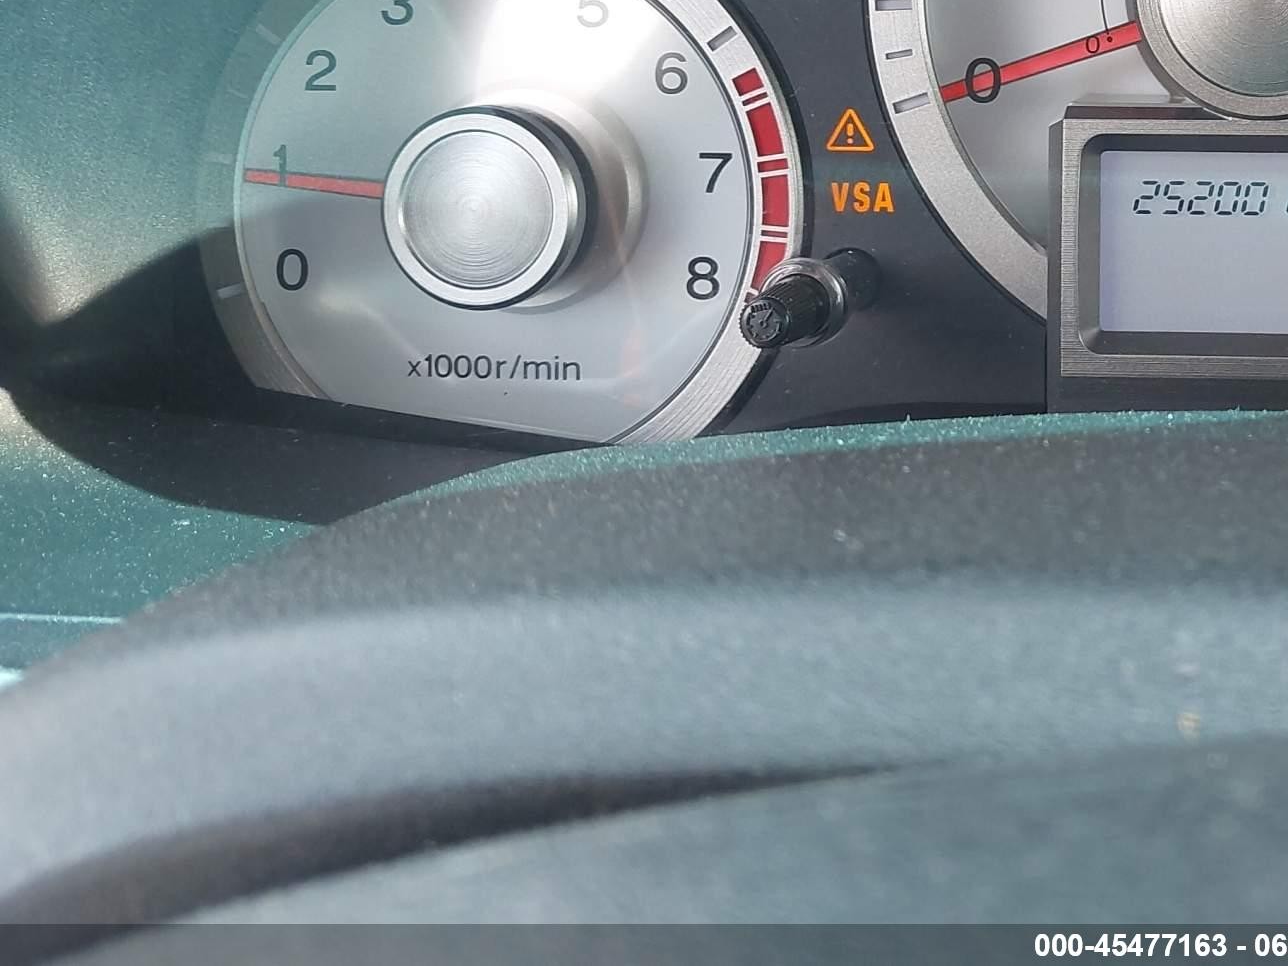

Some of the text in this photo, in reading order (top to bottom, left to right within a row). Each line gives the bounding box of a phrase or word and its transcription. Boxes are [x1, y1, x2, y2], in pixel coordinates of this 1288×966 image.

[1085, 35, 1100, 53] 0
[305, 50, 337, 91] 2
[654, 53, 688, 94] 6
[964, 57, 1001, 103] 0
[273, 145, 287, 186] 1
[700, 153, 733, 193] 7
[831, 183, 894, 212] VSA
[276, 249, 309, 291] 0
[686, 257, 719, 300] 8
[407, 355, 581, 381] x1000r/min
